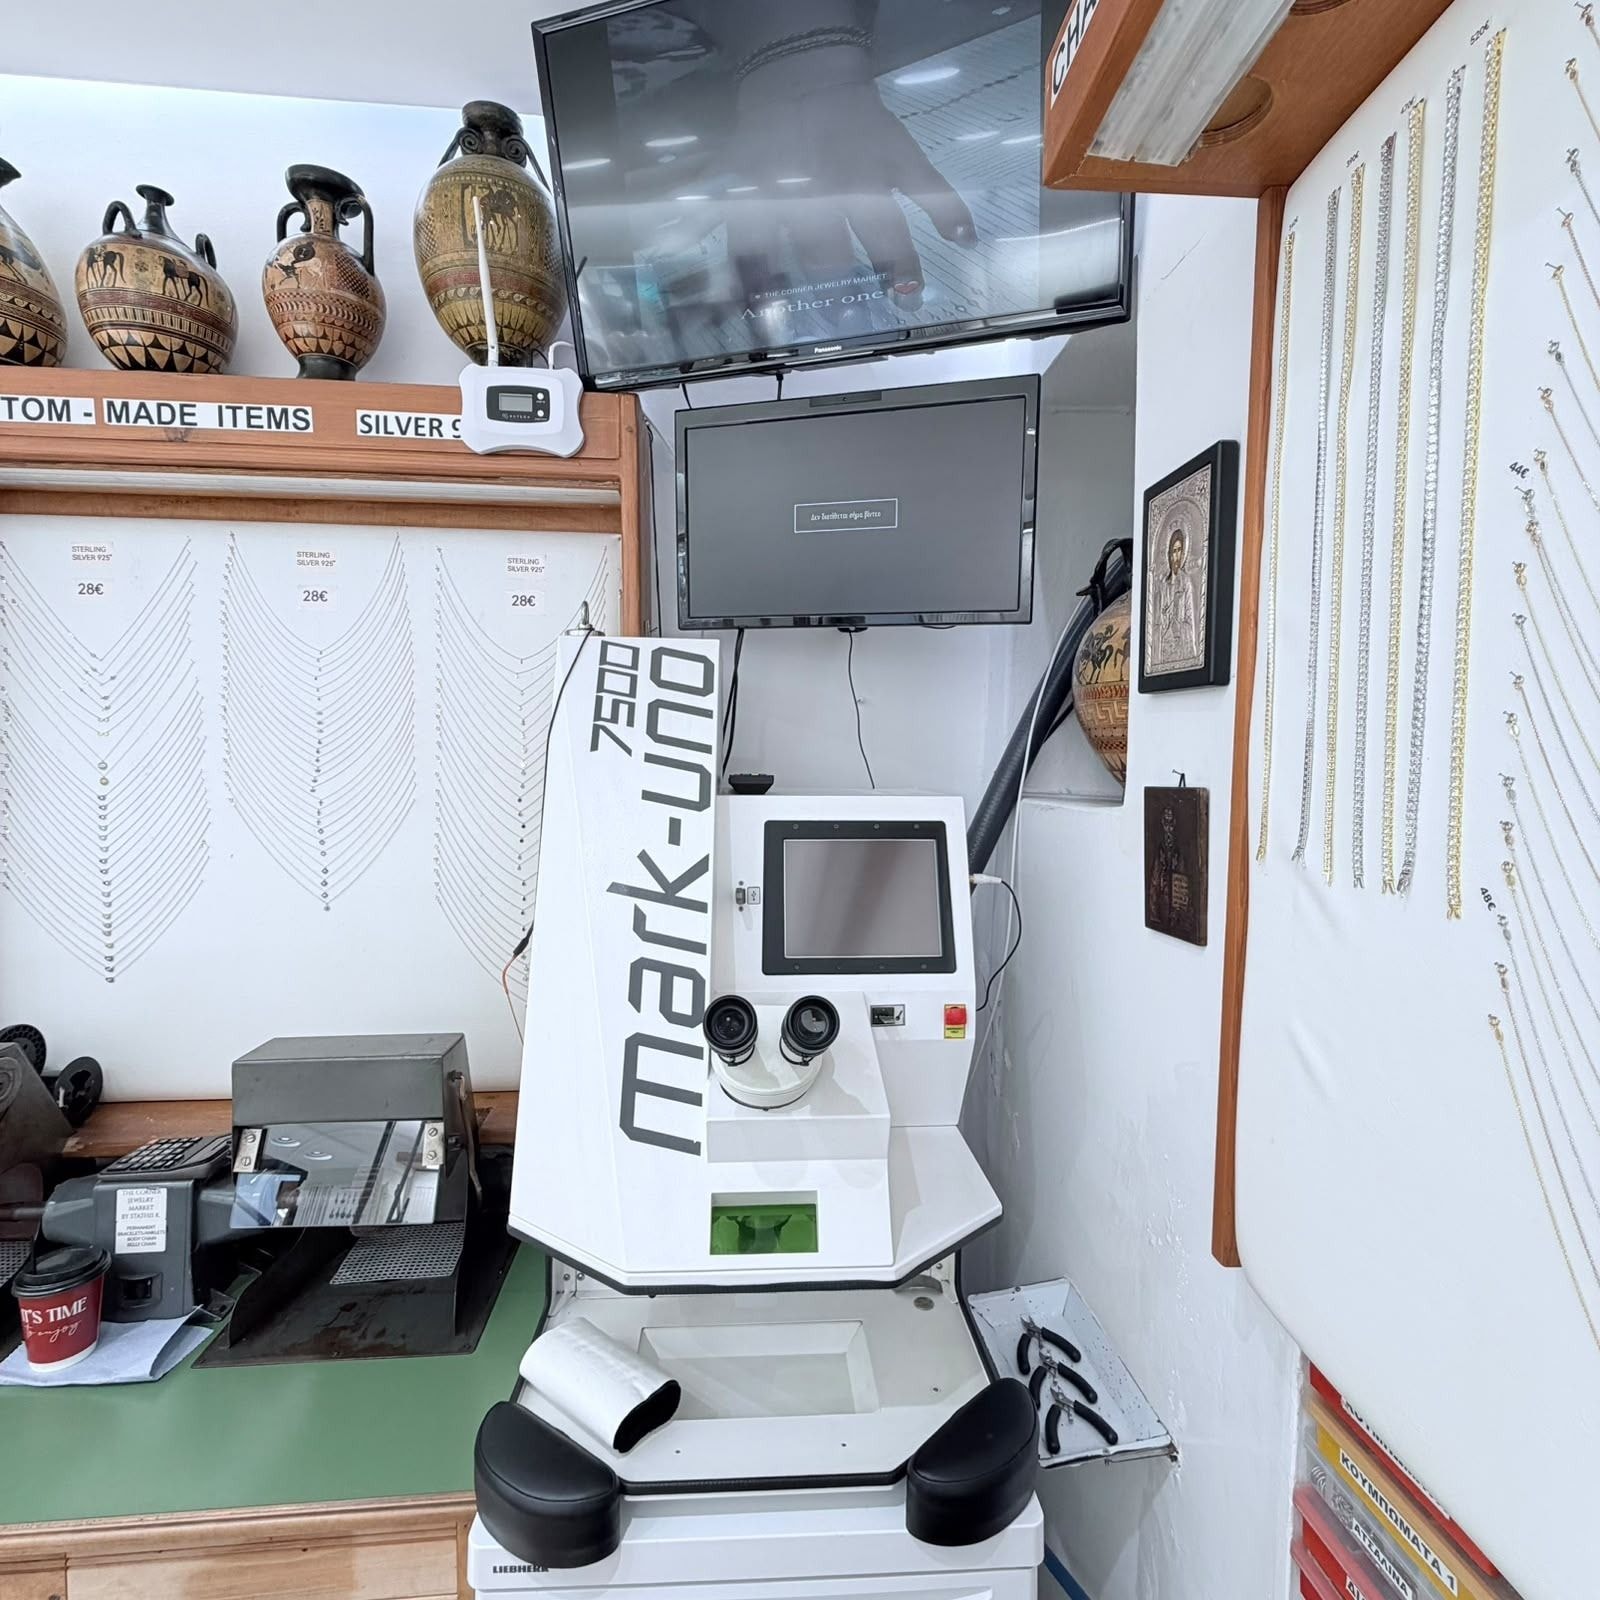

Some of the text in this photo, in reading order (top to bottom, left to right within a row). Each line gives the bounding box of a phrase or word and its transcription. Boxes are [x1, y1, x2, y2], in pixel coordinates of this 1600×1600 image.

[781, 284, 814, 296] CORNER
[814, 279, 851, 290] JEWELRY
[853, 273, 888, 284] MARKET
[841, 290, 884, 304] one
[814, 345, 842, 354] Panasonic
[0, 396, 71, 422] TOM
[106, 400, 198, 427] MADE
[217, 404, 311, 431] ITEMS
[359, 414, 444, 438] SILVER
[1509, 462, 1530, 479] 44€
[71, 545, 107, 553] STERLING
[71, 553, 96, 561] SILVER
[296, 559, 320, 567] SILVER
[507, 557, 540, 565] STERLING
[507, 565, 530, 573] SILVER
[78, 582, 104, 595] 28€
[303, 590, 329, 602] 28€
[511, 594, 536, 607] 28€
[590, 640, 640, 757] 7500
[606, 645, 715, 1157] mark-uno
[46, 1296, 88, 1323] TIME
[37, 1320, 81, 1343] enjoy
[1341, 1452, 1442, 1577] ΚΟΥΜΠΩΜΑΤΑ
[1446, 1574, 1455, 1591] 1
